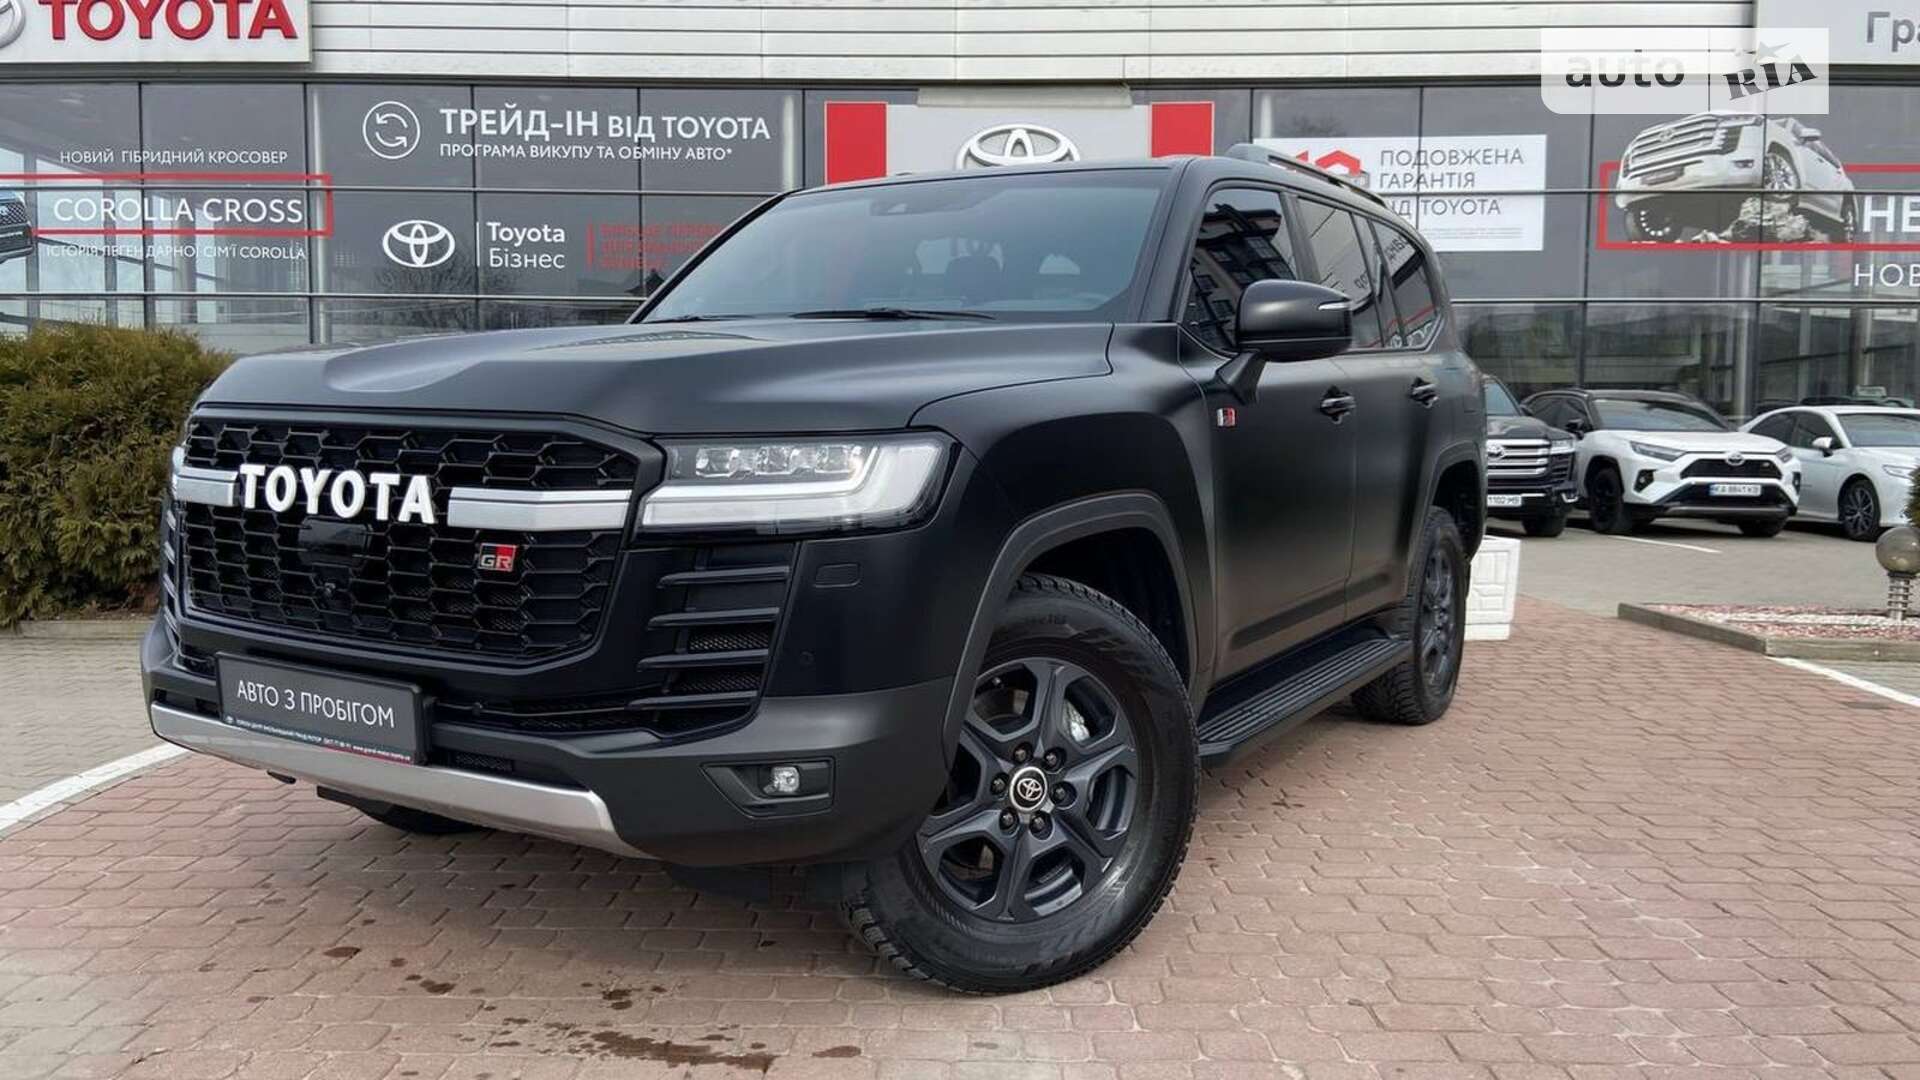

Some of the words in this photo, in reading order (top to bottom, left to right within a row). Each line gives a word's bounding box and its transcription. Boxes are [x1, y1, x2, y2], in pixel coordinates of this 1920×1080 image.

[38, 0, 298, 40] TOYOTA
[1866, 11, 1920, 52] Гр
[440, 103, 598, 141] ТРЕЙД-ІН
[607, 115, 655, 142] ВІД
[662, 115, 771, 139] TOYOTA
[60, 149, 114, 163] НОВИЙ
[122, 149, 204, 164] ГІБРИДНИЙ
[208, 151, 288, 164] КРОСОВЕР
[439, 143, 526, 159] ПРОГРАМА
[530, 145, 594, 160] ВИКУПУ
[598, 146, 615, 160] ТА
[618, 147, 681, 161] ОБМІНУ
[1380, 147, 1524, 168] ПОДОВЖЕНА
[1379, 171, 1476, 189] ГАРАНТІЯ
[53, 197, 195, 222] COROLLA
[203, 198, 303, 224] CROSS
[1421, 199, 1502, 216] TOYOTA
[486, 222, 566, 247] Toyota
[240, 245, 306, 260] COROLLA
[489, 247, 566, 269] Бізнес
[240, 463, 436, 525] TOYOTA
[479, 553, 514, 570] GR
[237, 679, 280, 707] АВТО
[283, 689, 296, 710] З
[301, 691, 395, 729] ПРОБІГОМ
